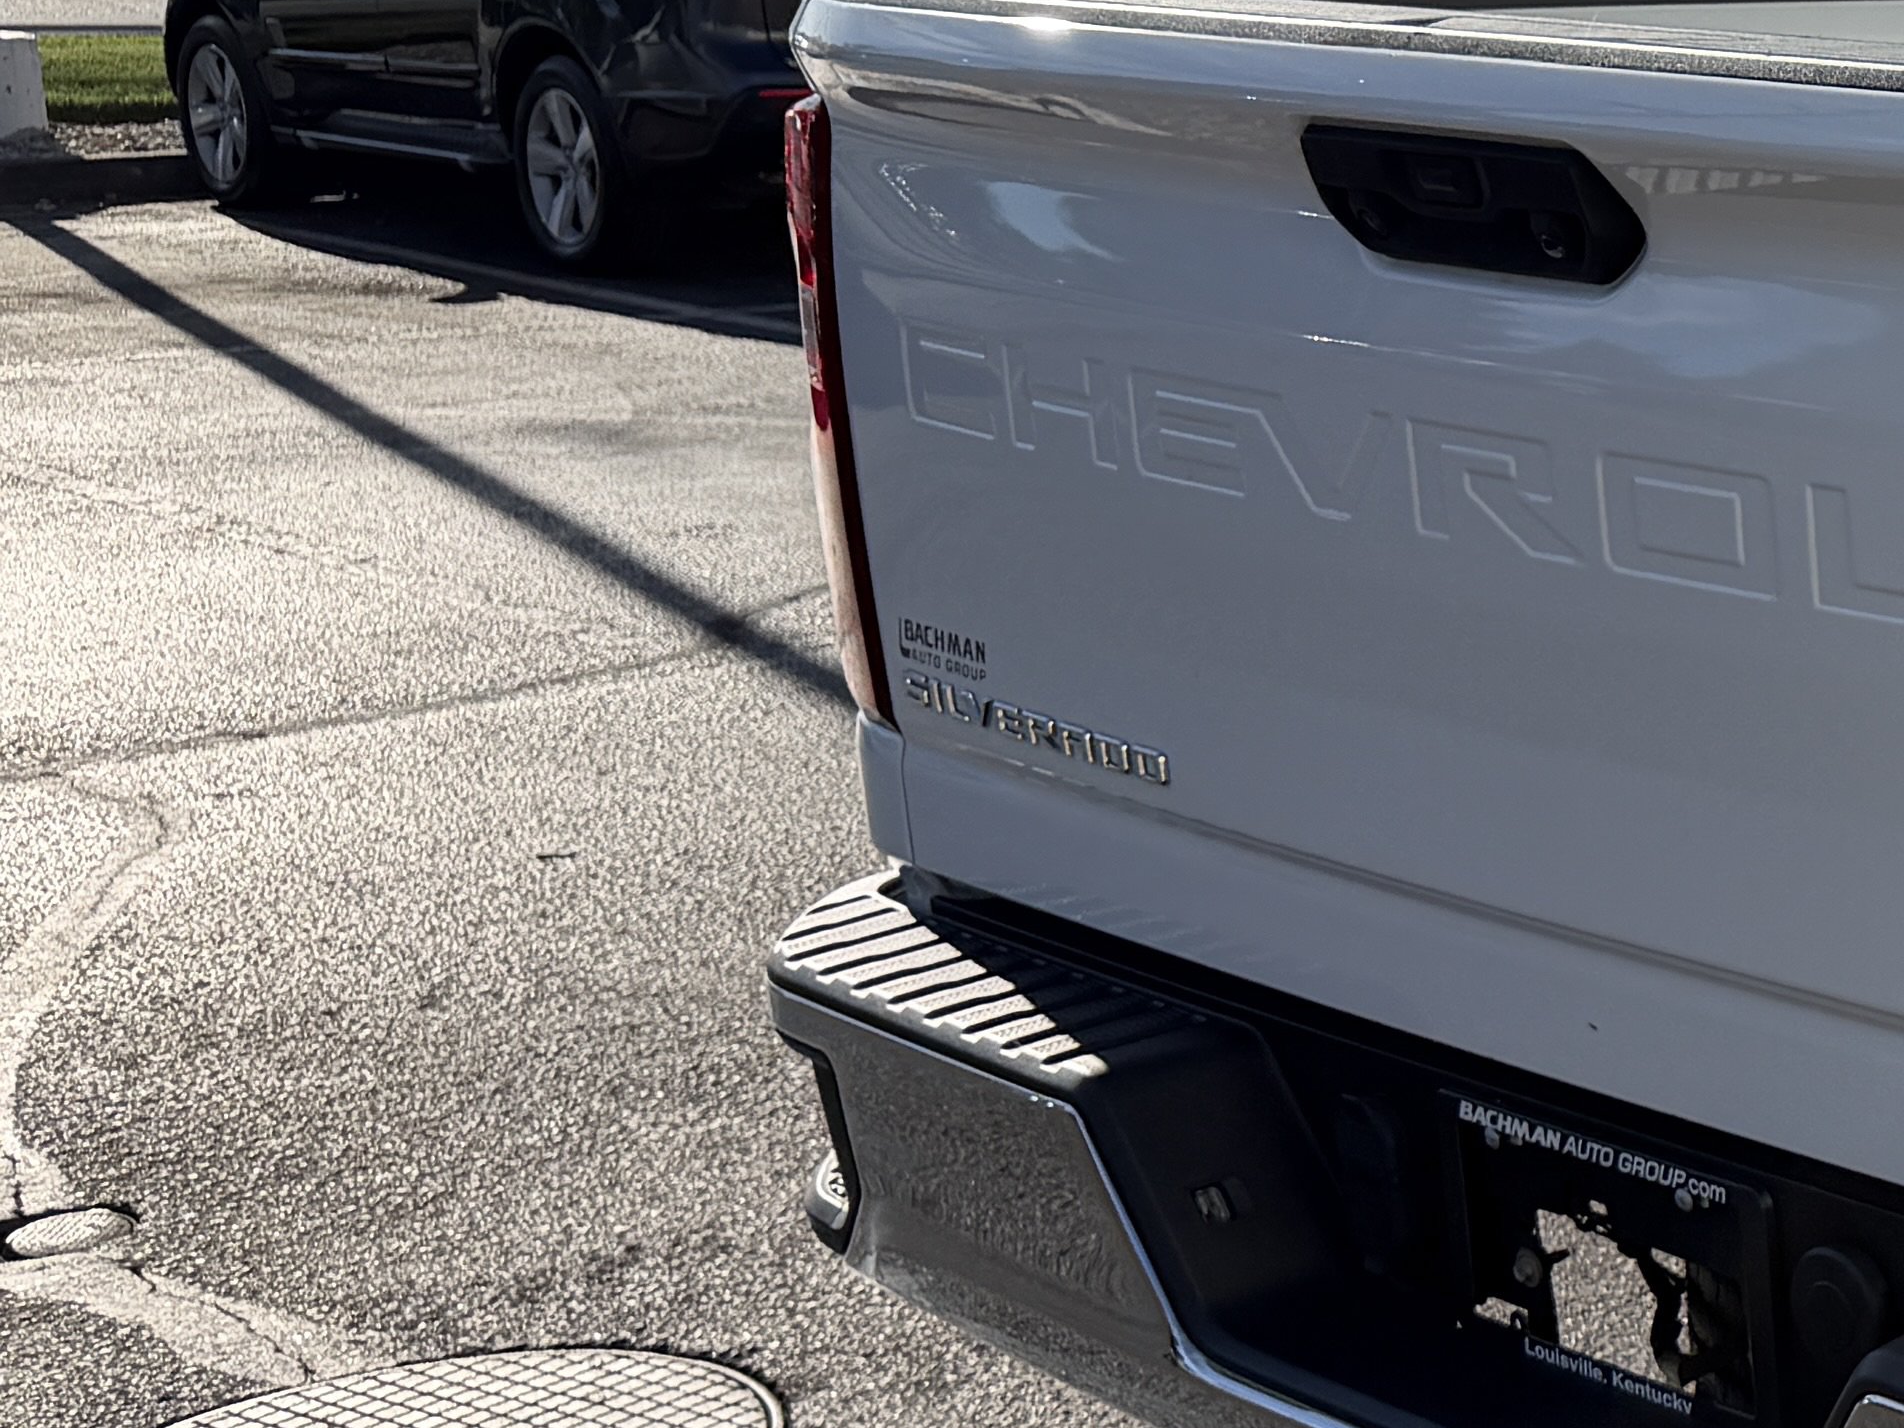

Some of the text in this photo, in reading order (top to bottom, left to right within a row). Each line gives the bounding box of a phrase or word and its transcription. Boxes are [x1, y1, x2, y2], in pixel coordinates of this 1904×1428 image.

[903, 618, 987, 664] BACHMAN
[911, 649, 987, 682] AUTO GROUP
[903, 667, 1172, 786] SILVERADO
[1459, 1099, 1562, 1151] BACHMAN
[1562, 1135, 1615, 1168] AUTO
[1524, 1336, 1693, 1415] Louisville, Kentucky
